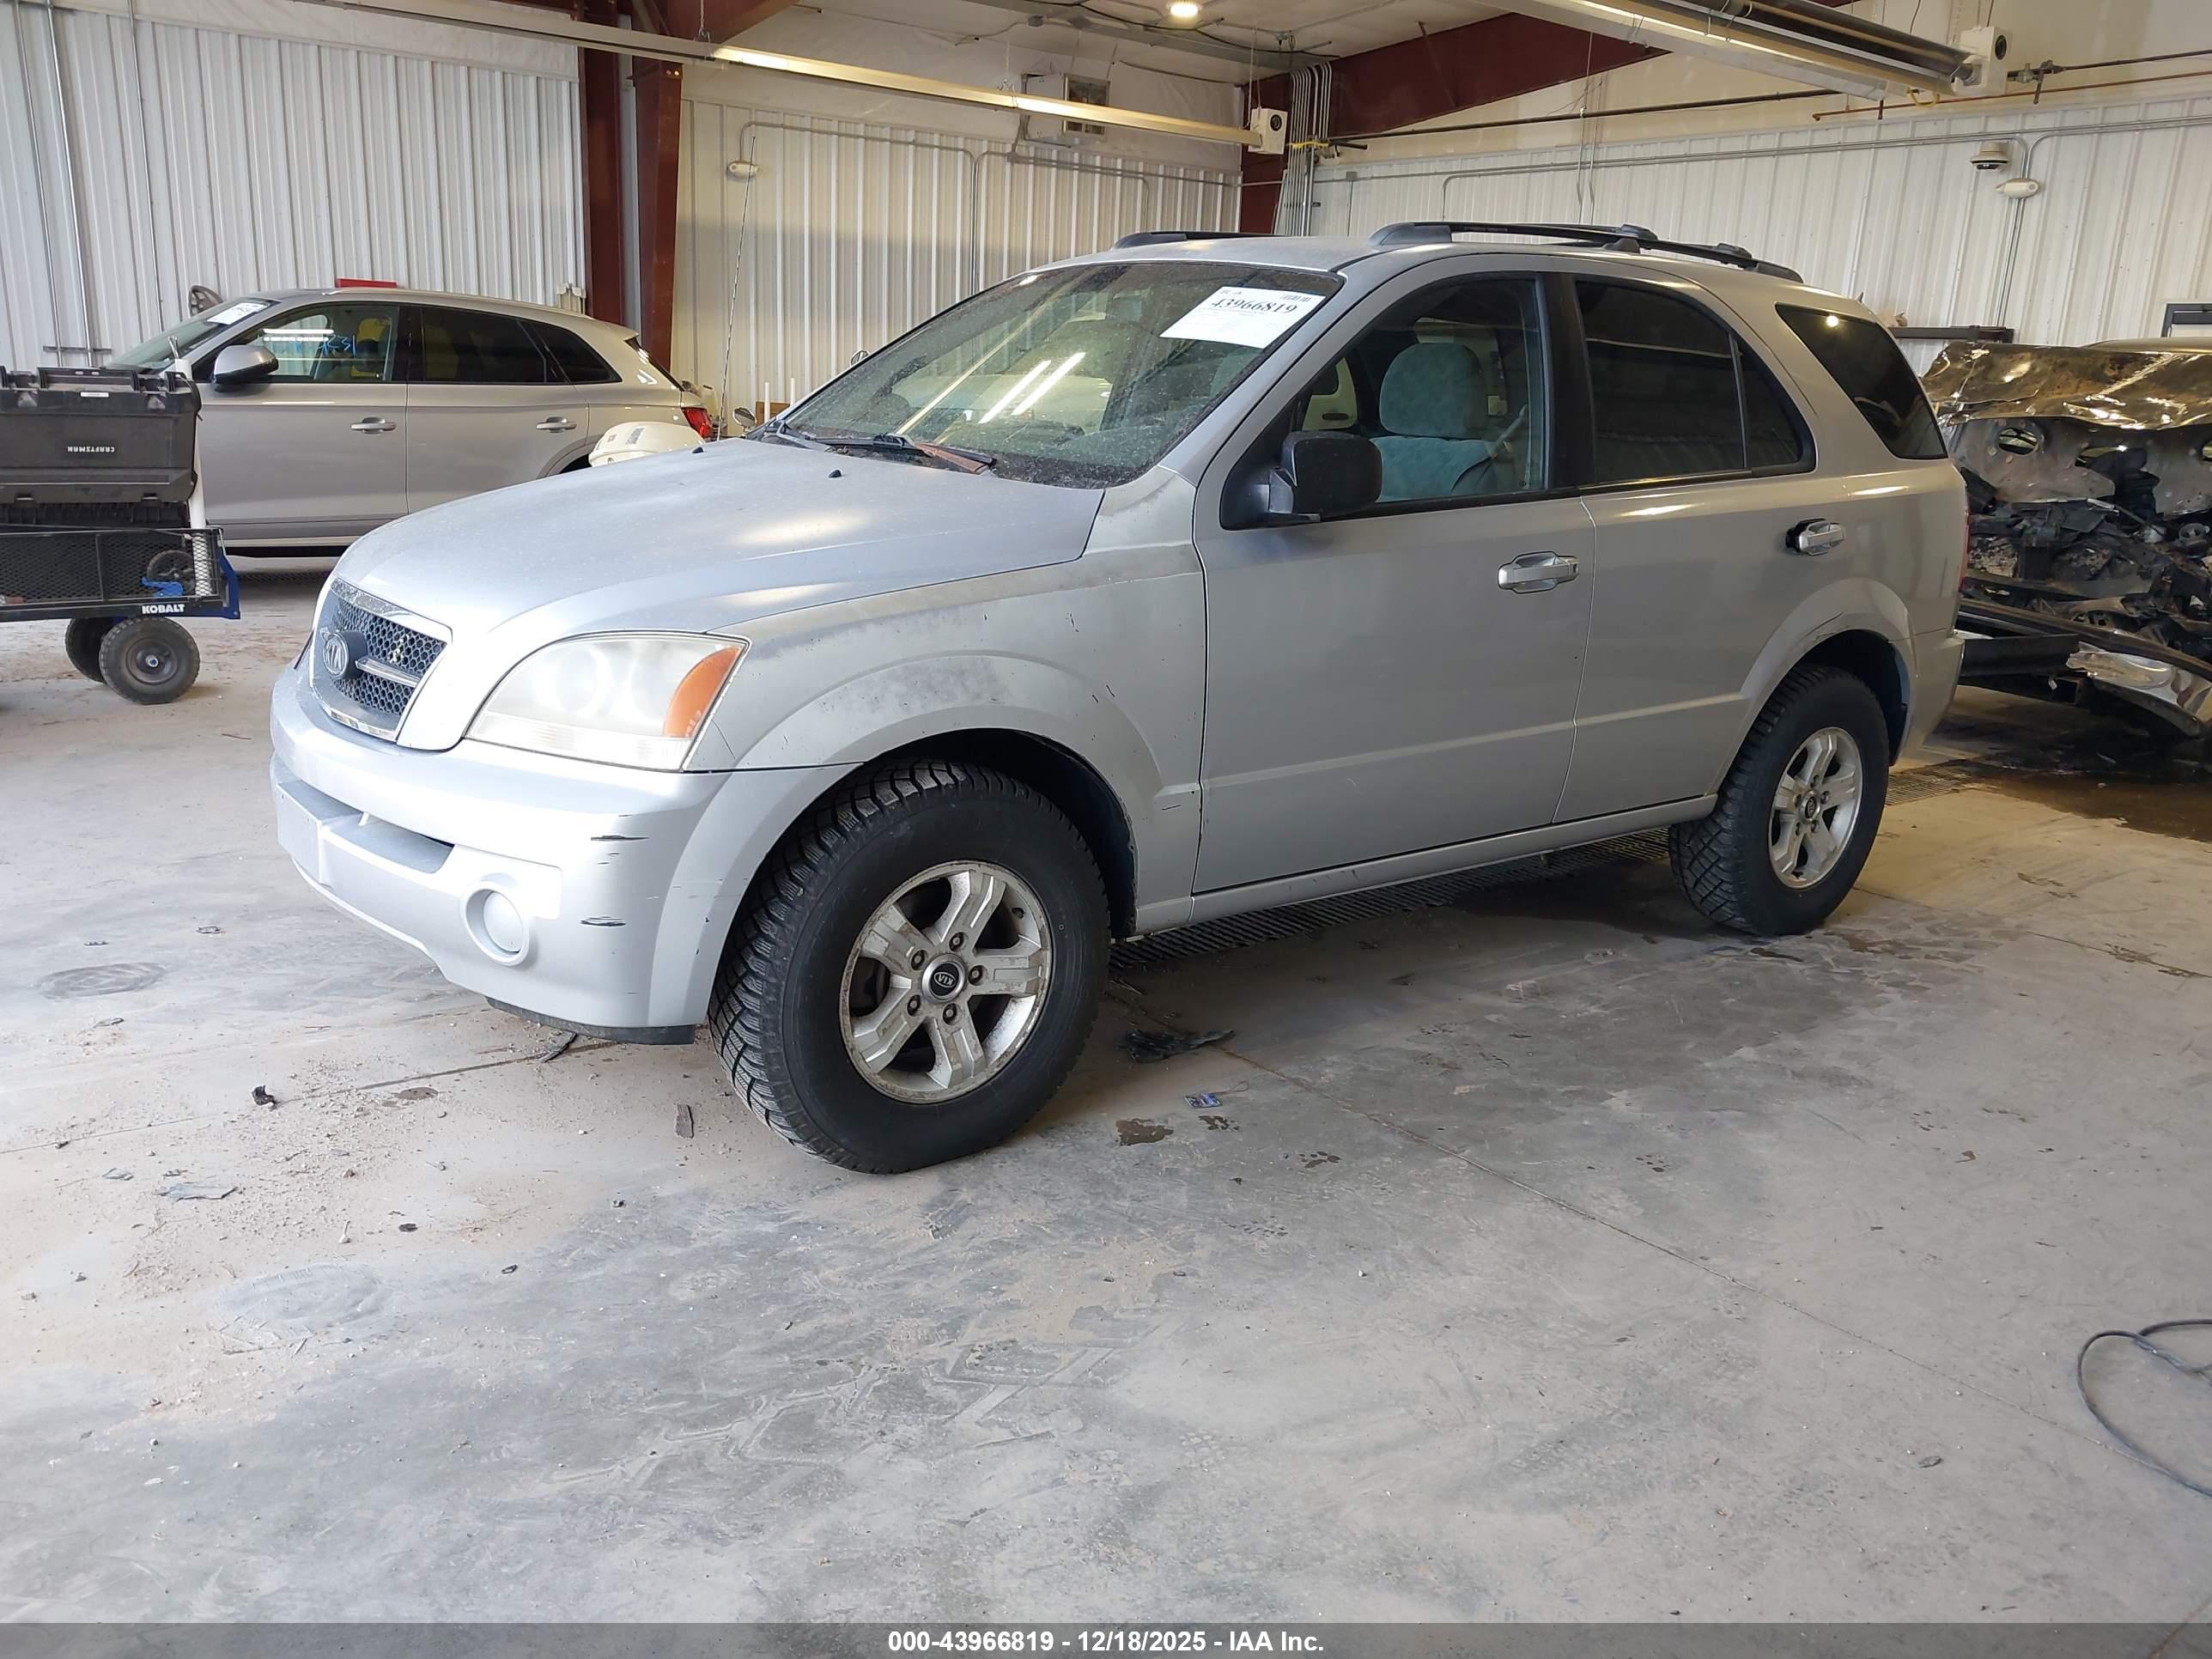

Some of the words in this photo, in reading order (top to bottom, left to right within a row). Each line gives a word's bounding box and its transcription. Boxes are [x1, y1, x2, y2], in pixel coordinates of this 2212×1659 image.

[1212, 298, 1298, 314] 43966819
[142, 604, 185, 615] KOBALT
[938, 974, 954, 986] KIA
